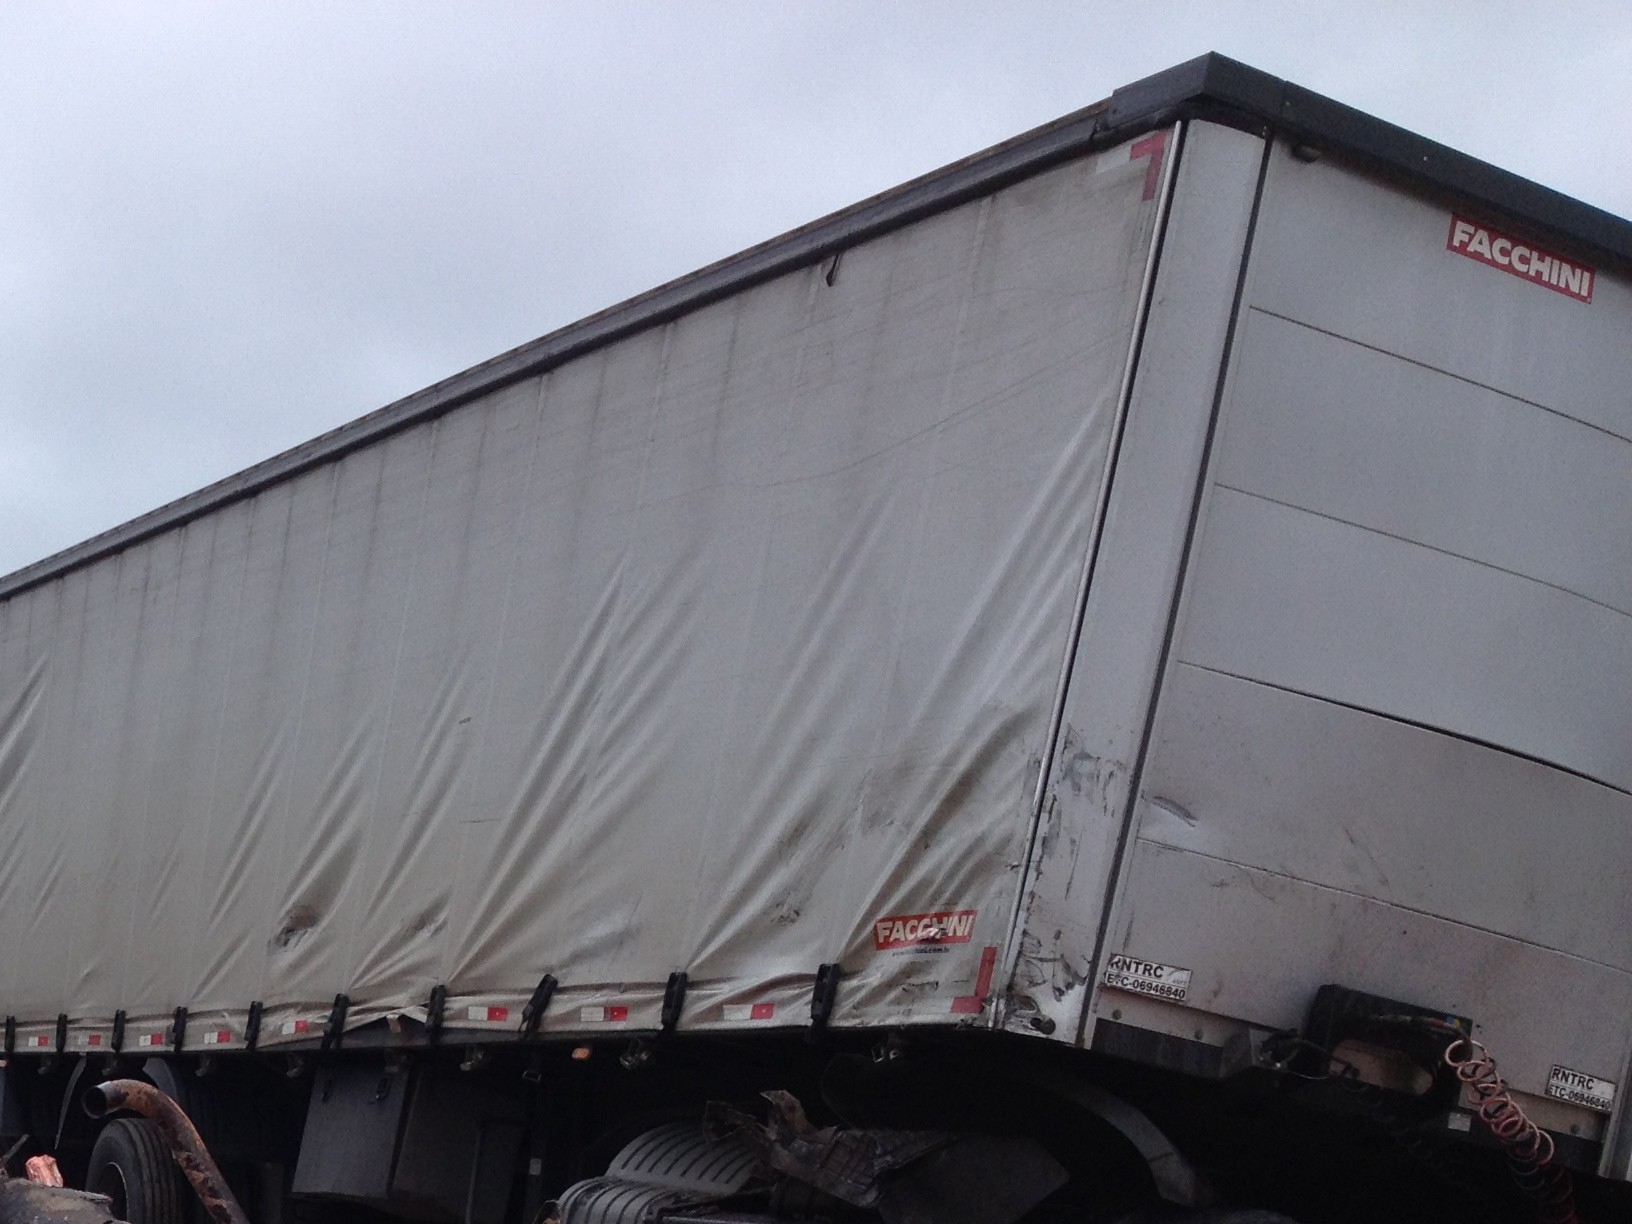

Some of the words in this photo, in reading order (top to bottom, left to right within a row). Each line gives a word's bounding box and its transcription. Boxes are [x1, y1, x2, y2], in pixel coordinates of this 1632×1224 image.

[1452, 220, 1591, 297] FACCHINI
[876, 914, 975, 943] FACCHINI
[1551, 1068, 1595, 1090] RNTRC
